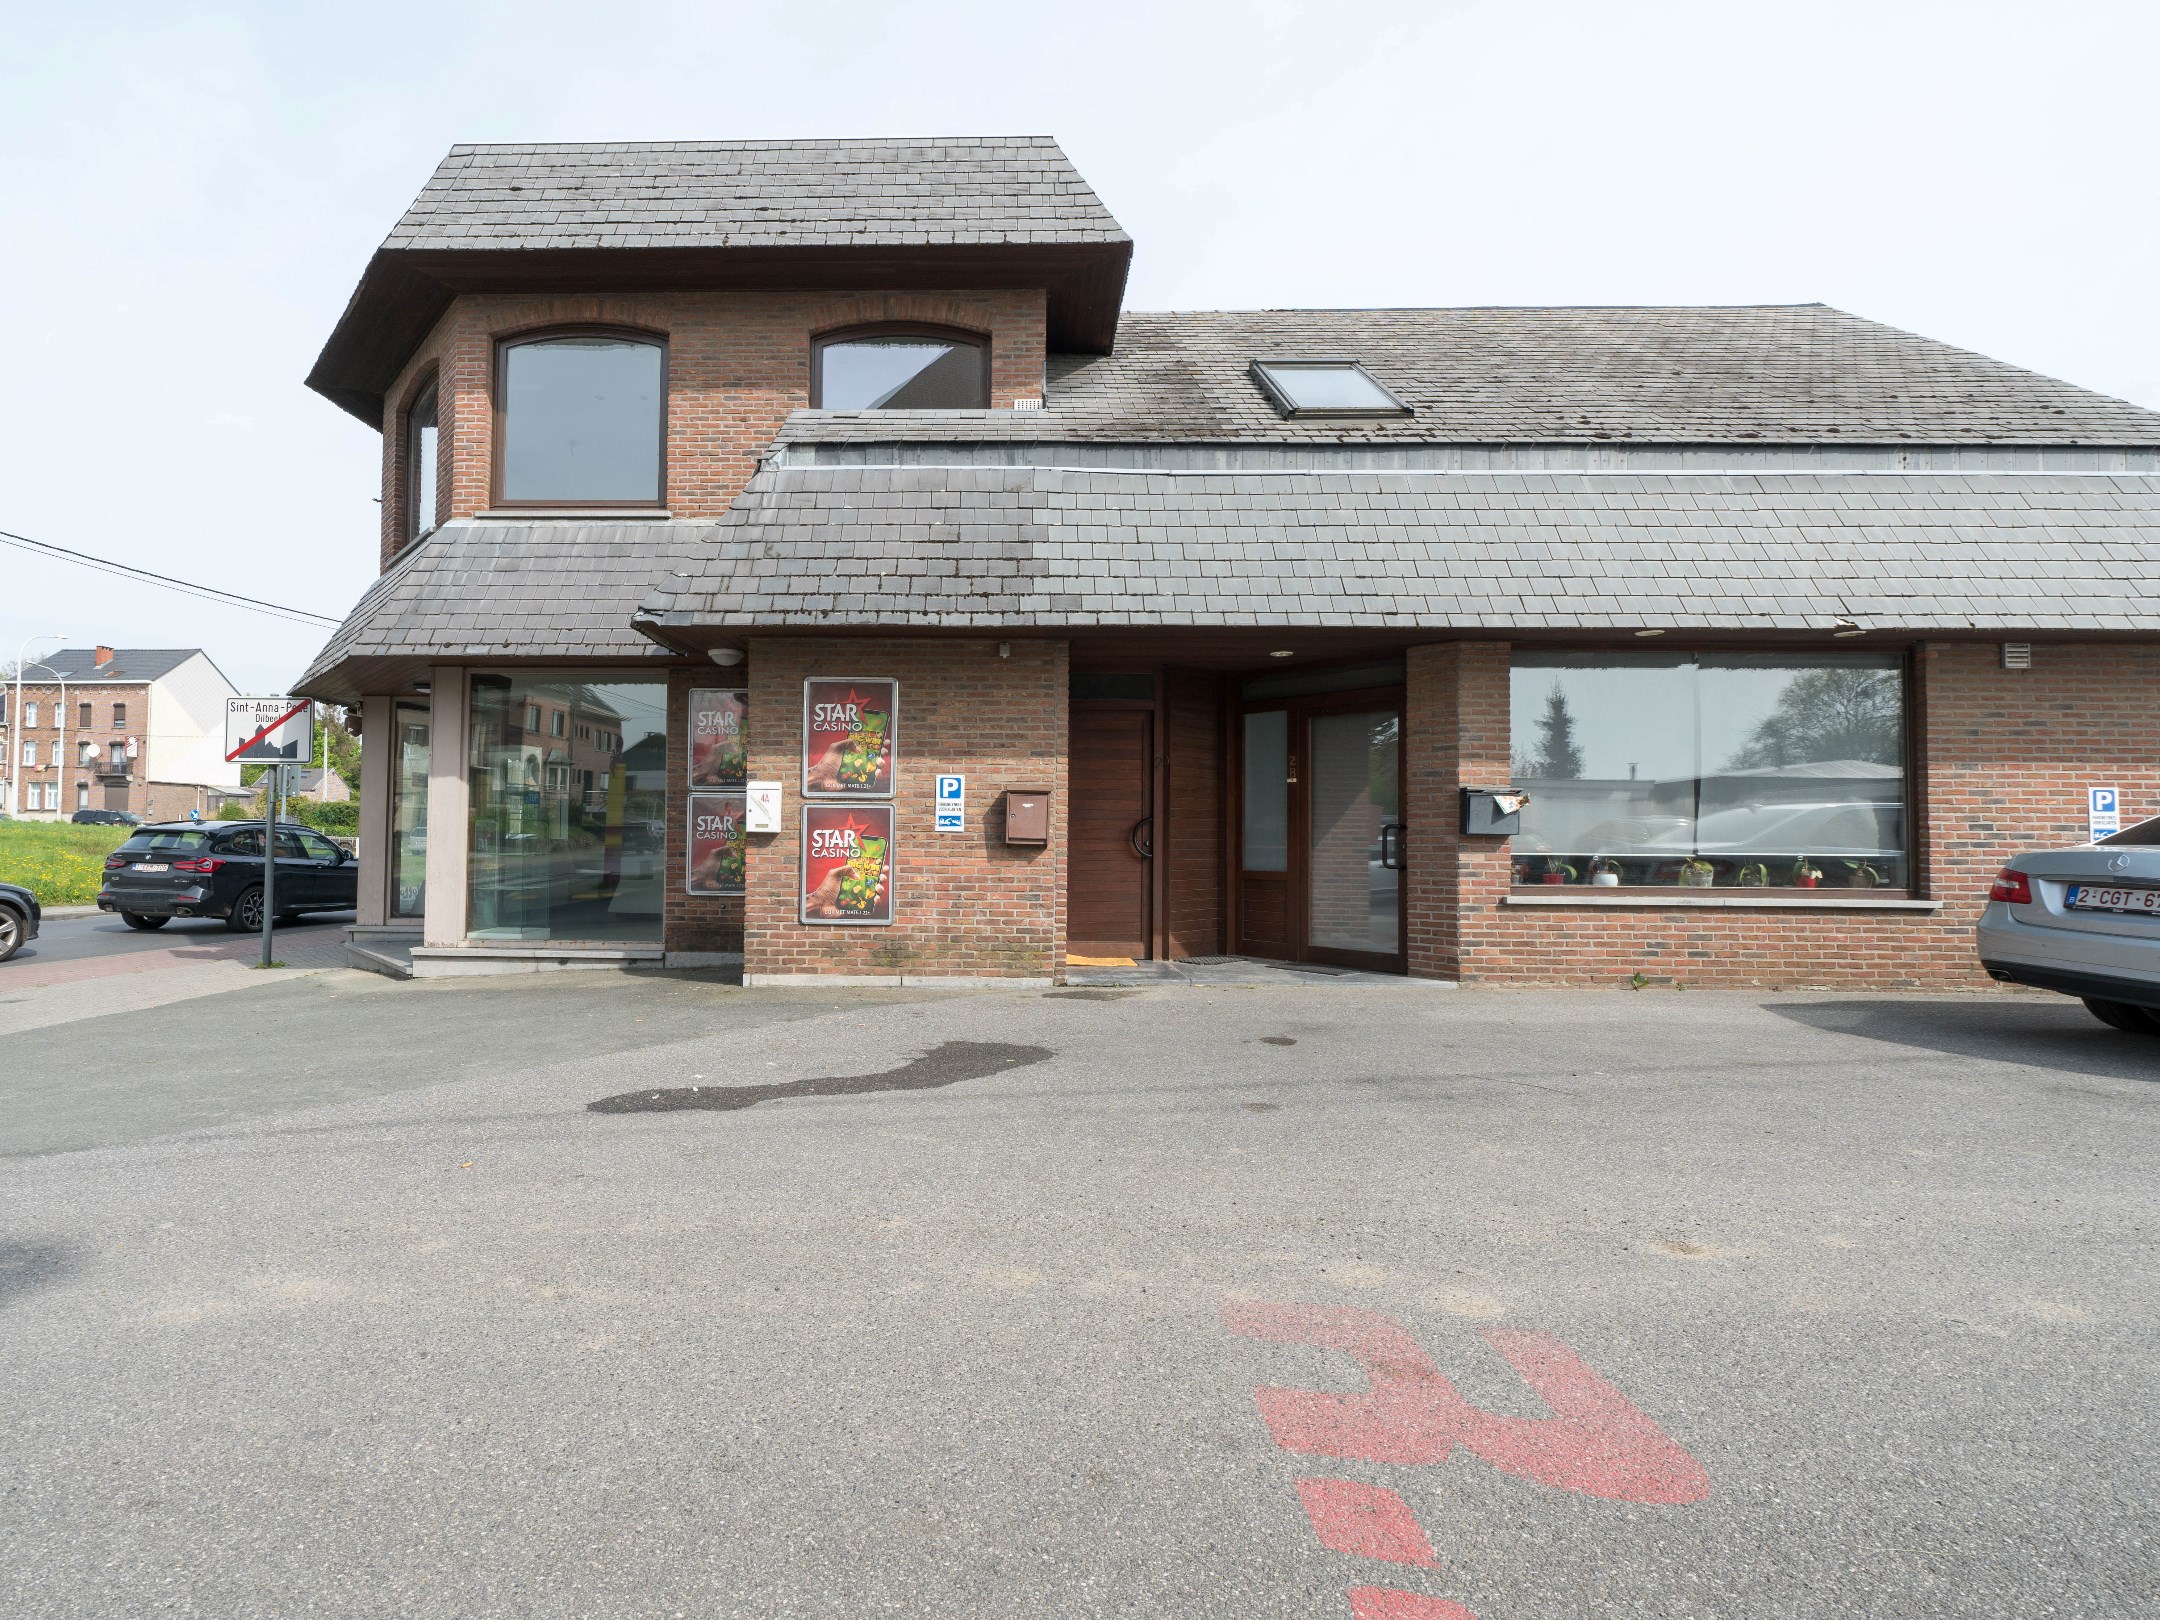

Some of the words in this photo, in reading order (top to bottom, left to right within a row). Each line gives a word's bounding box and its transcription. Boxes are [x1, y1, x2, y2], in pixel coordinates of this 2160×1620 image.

[698, 711, 736, 726] STAR
[814, 703, 860, 722] STAR
[697, 726, 738, 735] CASINO
[814, 722, 862, 732] CASINO
[942, 779, 958, 797] P
[2096, 792, 2112, 810] P
[696, 816, 734, 831] STAR
[696, 832, 737, 840] CASINO
[812, 829, 857, 848] STAR
[812, 848, 860, 858] CASINO
